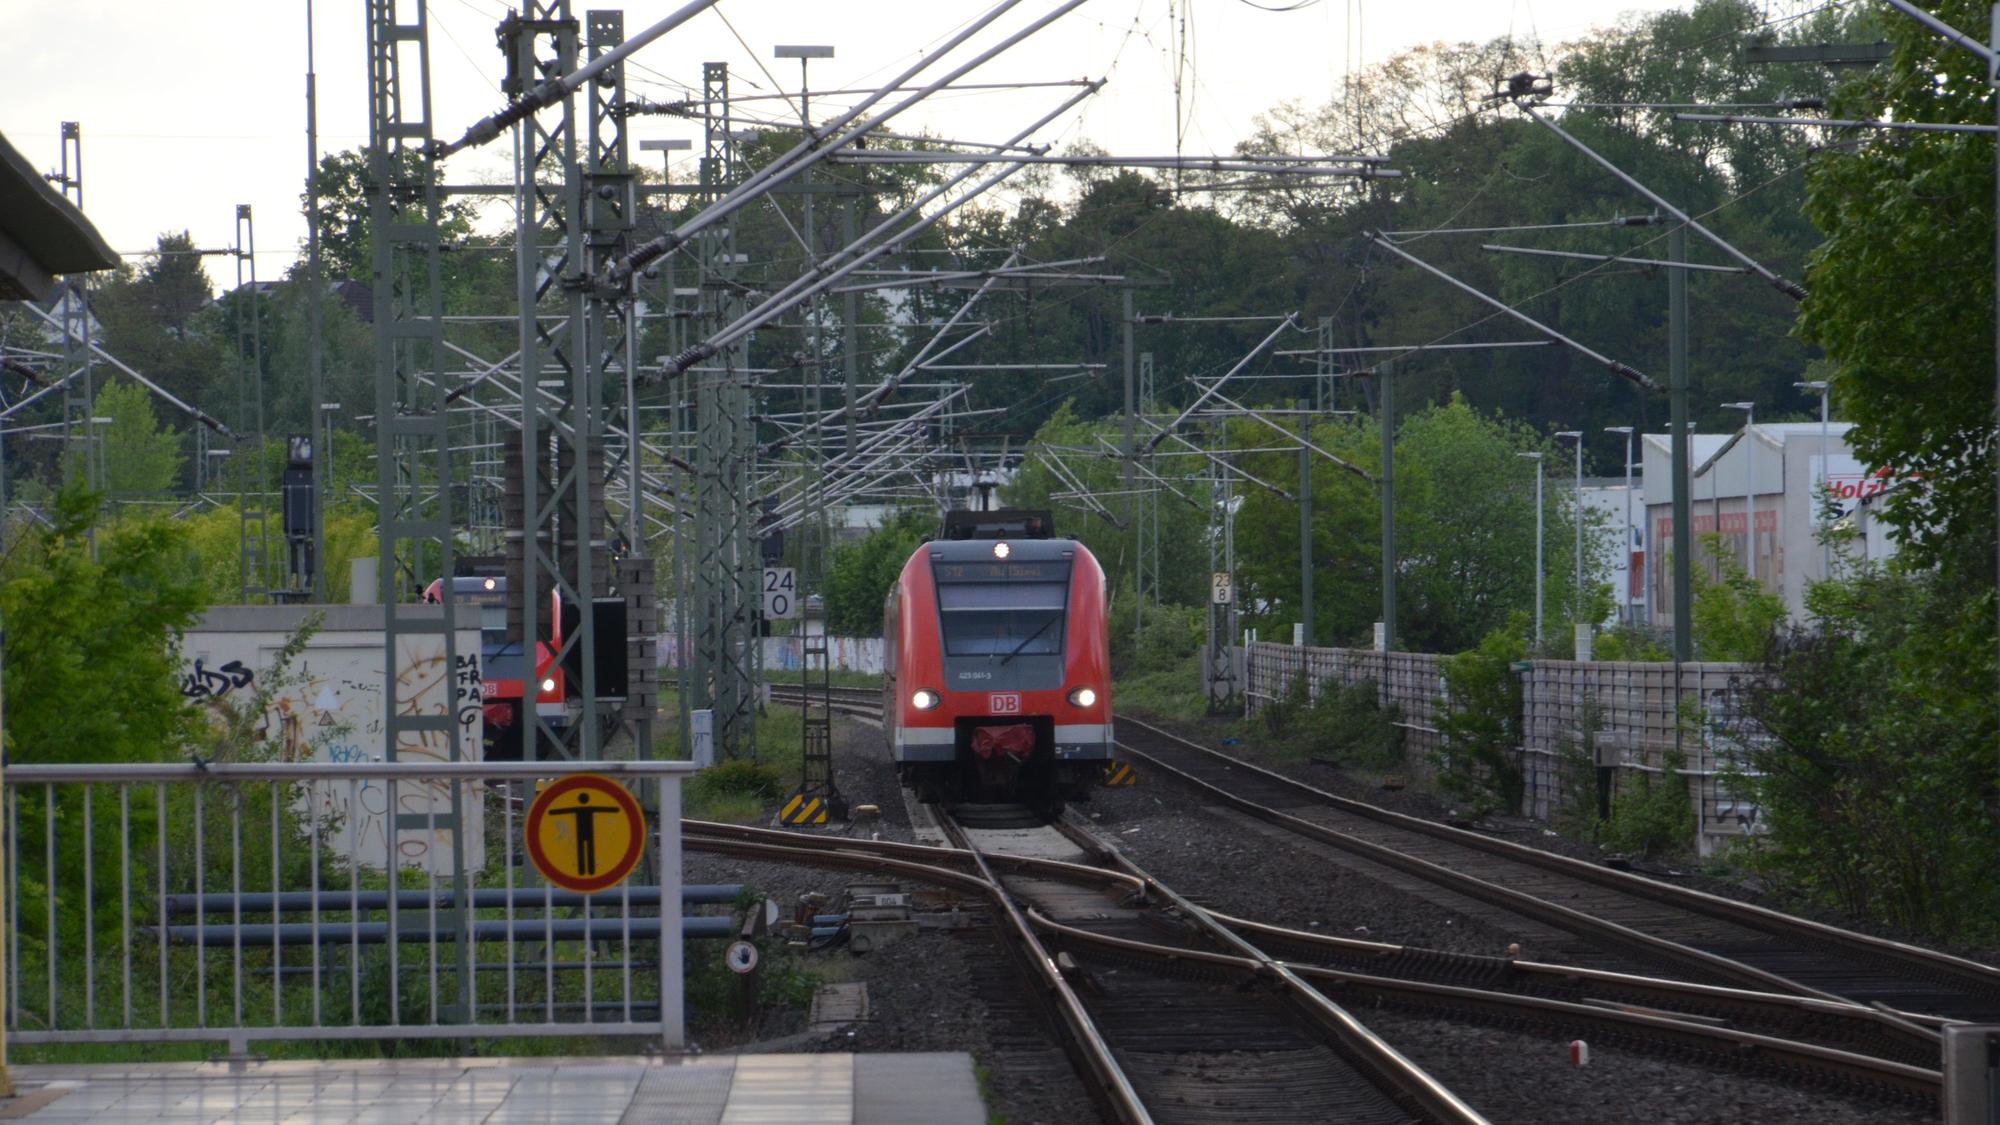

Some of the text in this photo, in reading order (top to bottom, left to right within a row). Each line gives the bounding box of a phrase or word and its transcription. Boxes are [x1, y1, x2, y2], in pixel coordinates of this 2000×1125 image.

[765, 570, 794, 592] 24
[1215, 574, 1231, 587] 23
[1218, 588, 1226, 601] 8
[993, 696, 1017, 711] DB
